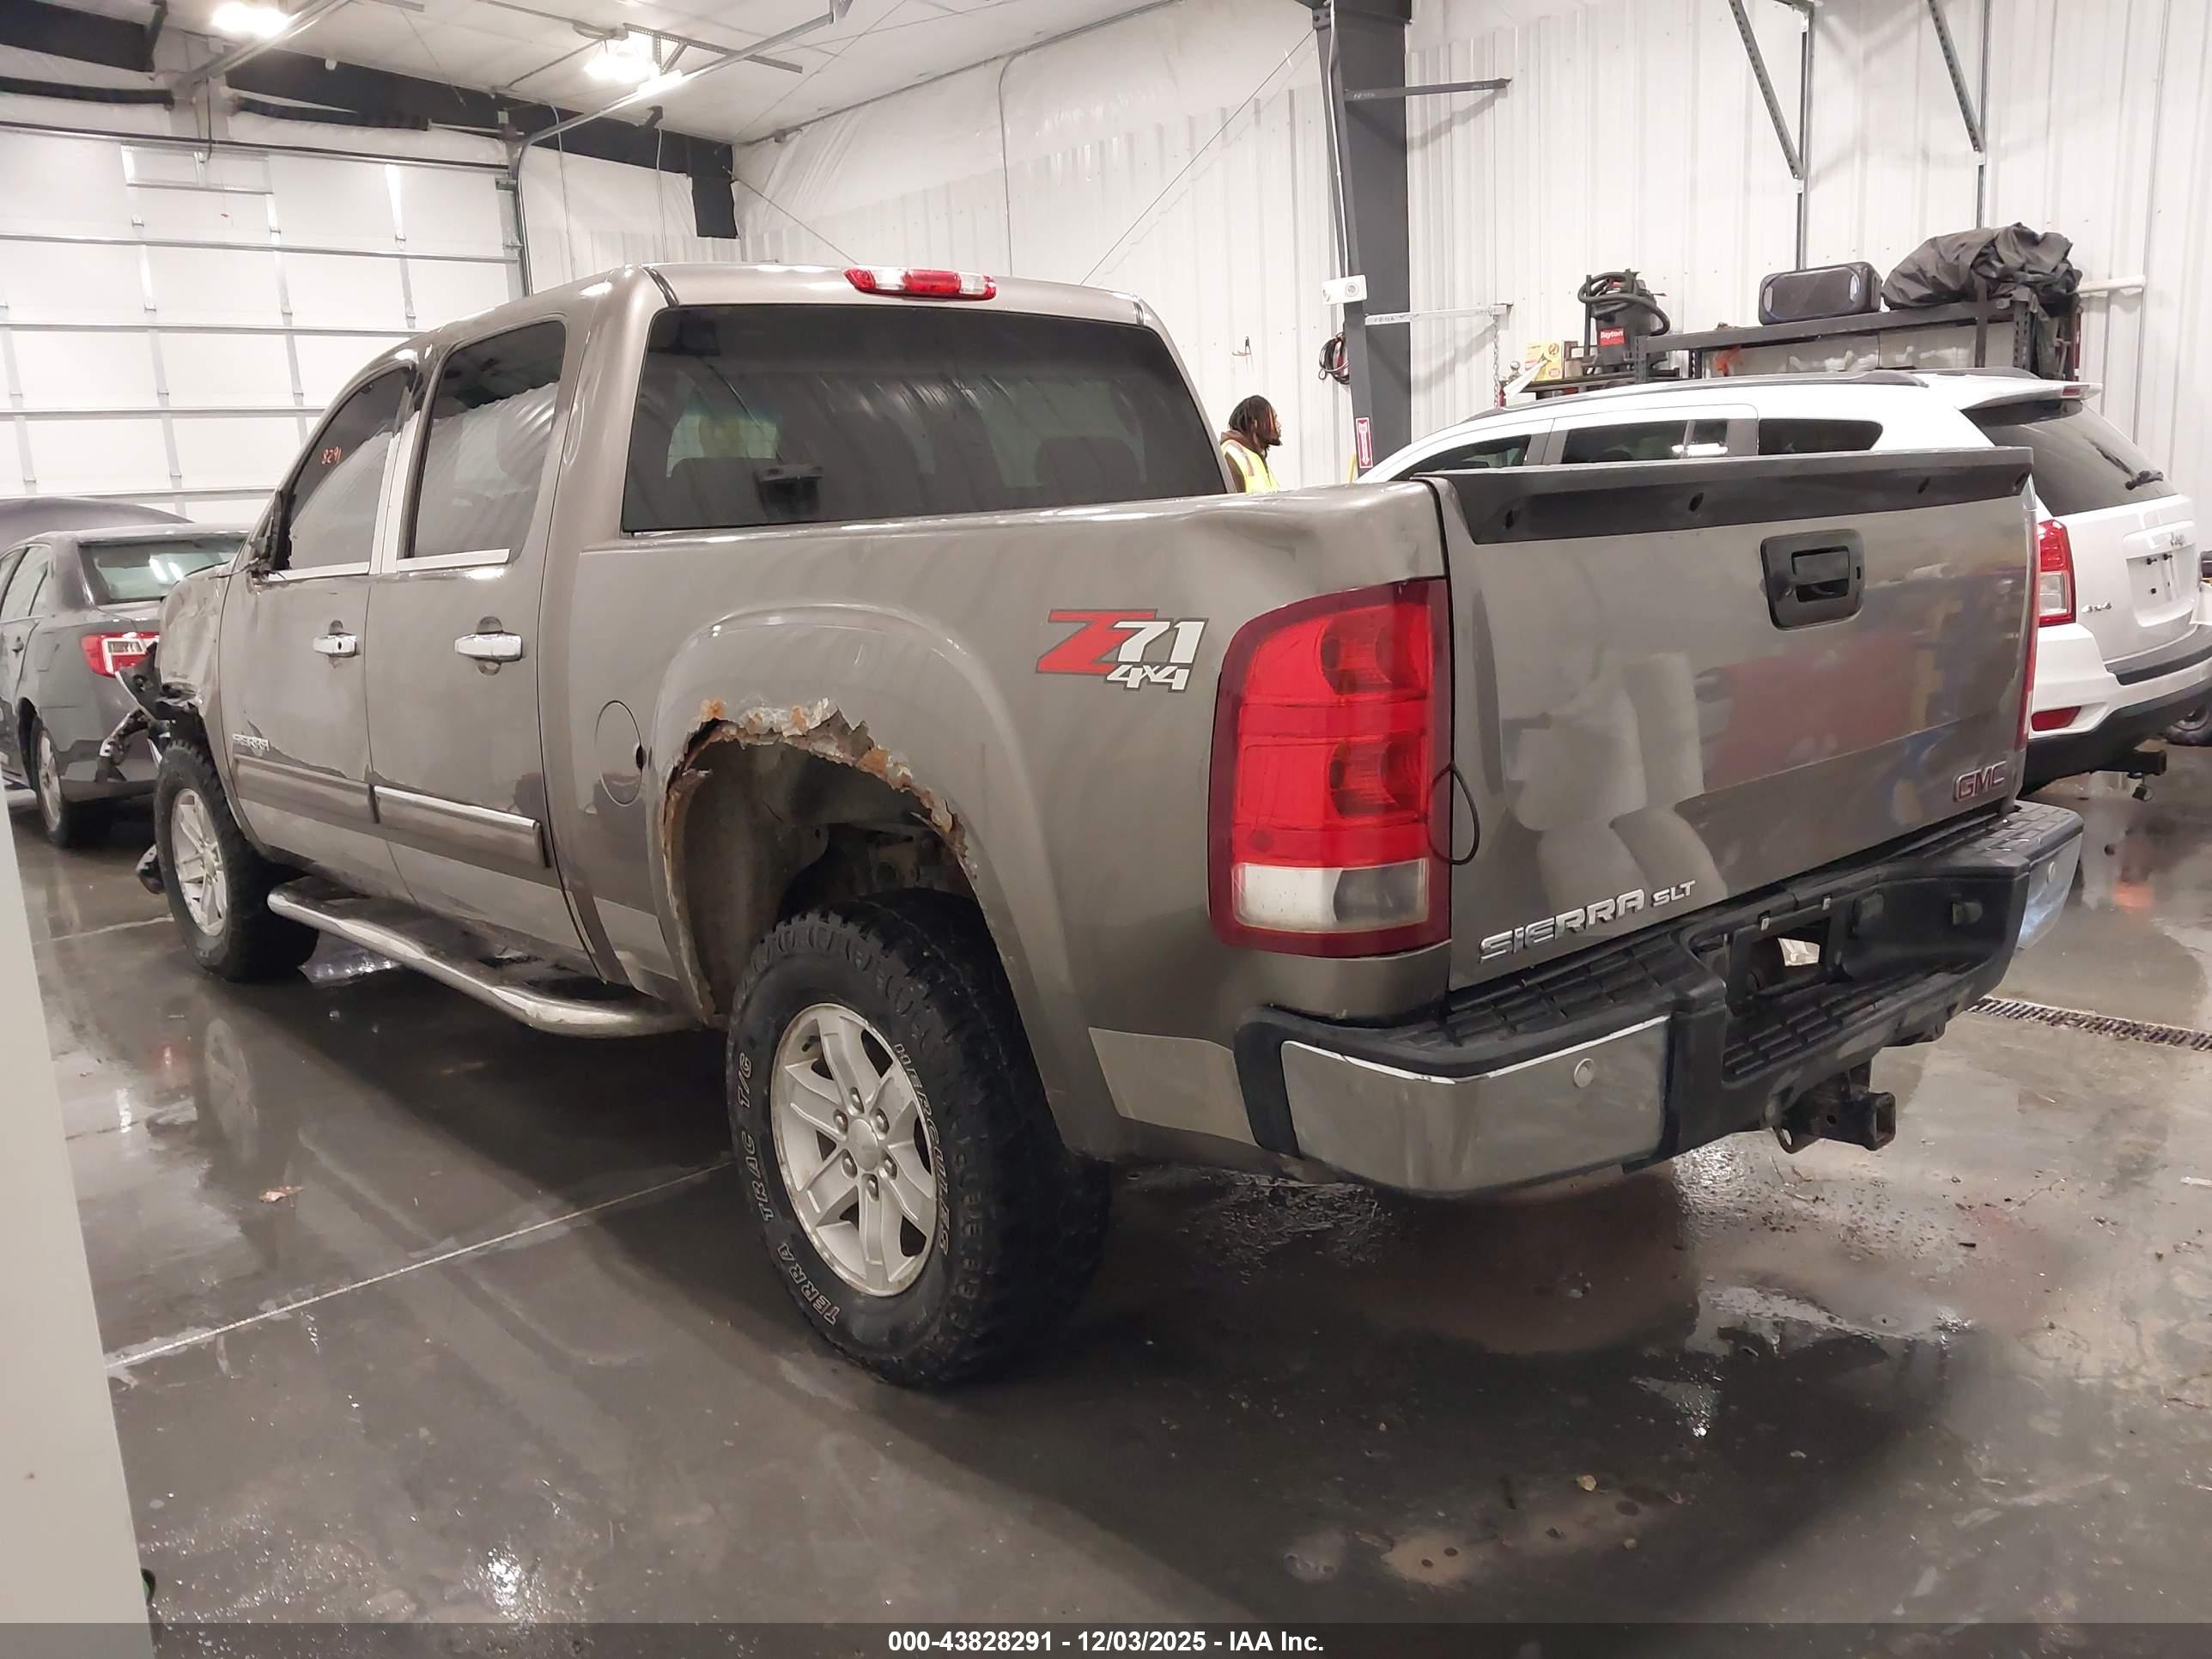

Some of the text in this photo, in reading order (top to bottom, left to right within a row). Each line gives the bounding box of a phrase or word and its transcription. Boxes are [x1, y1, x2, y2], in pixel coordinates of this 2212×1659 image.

[1600, 330, 1624, 340] Dayton
[322, 447, 342, 465] 8291
[1036, 609, 1209, 676] Z71
[1956, 761, 2007, 800] GMC
[1480, 879, 1697, 963] SIERRA SLT
[741, 1131, 774, 1221] TRAC
[776, 1243, 842, 1326] TERRA
